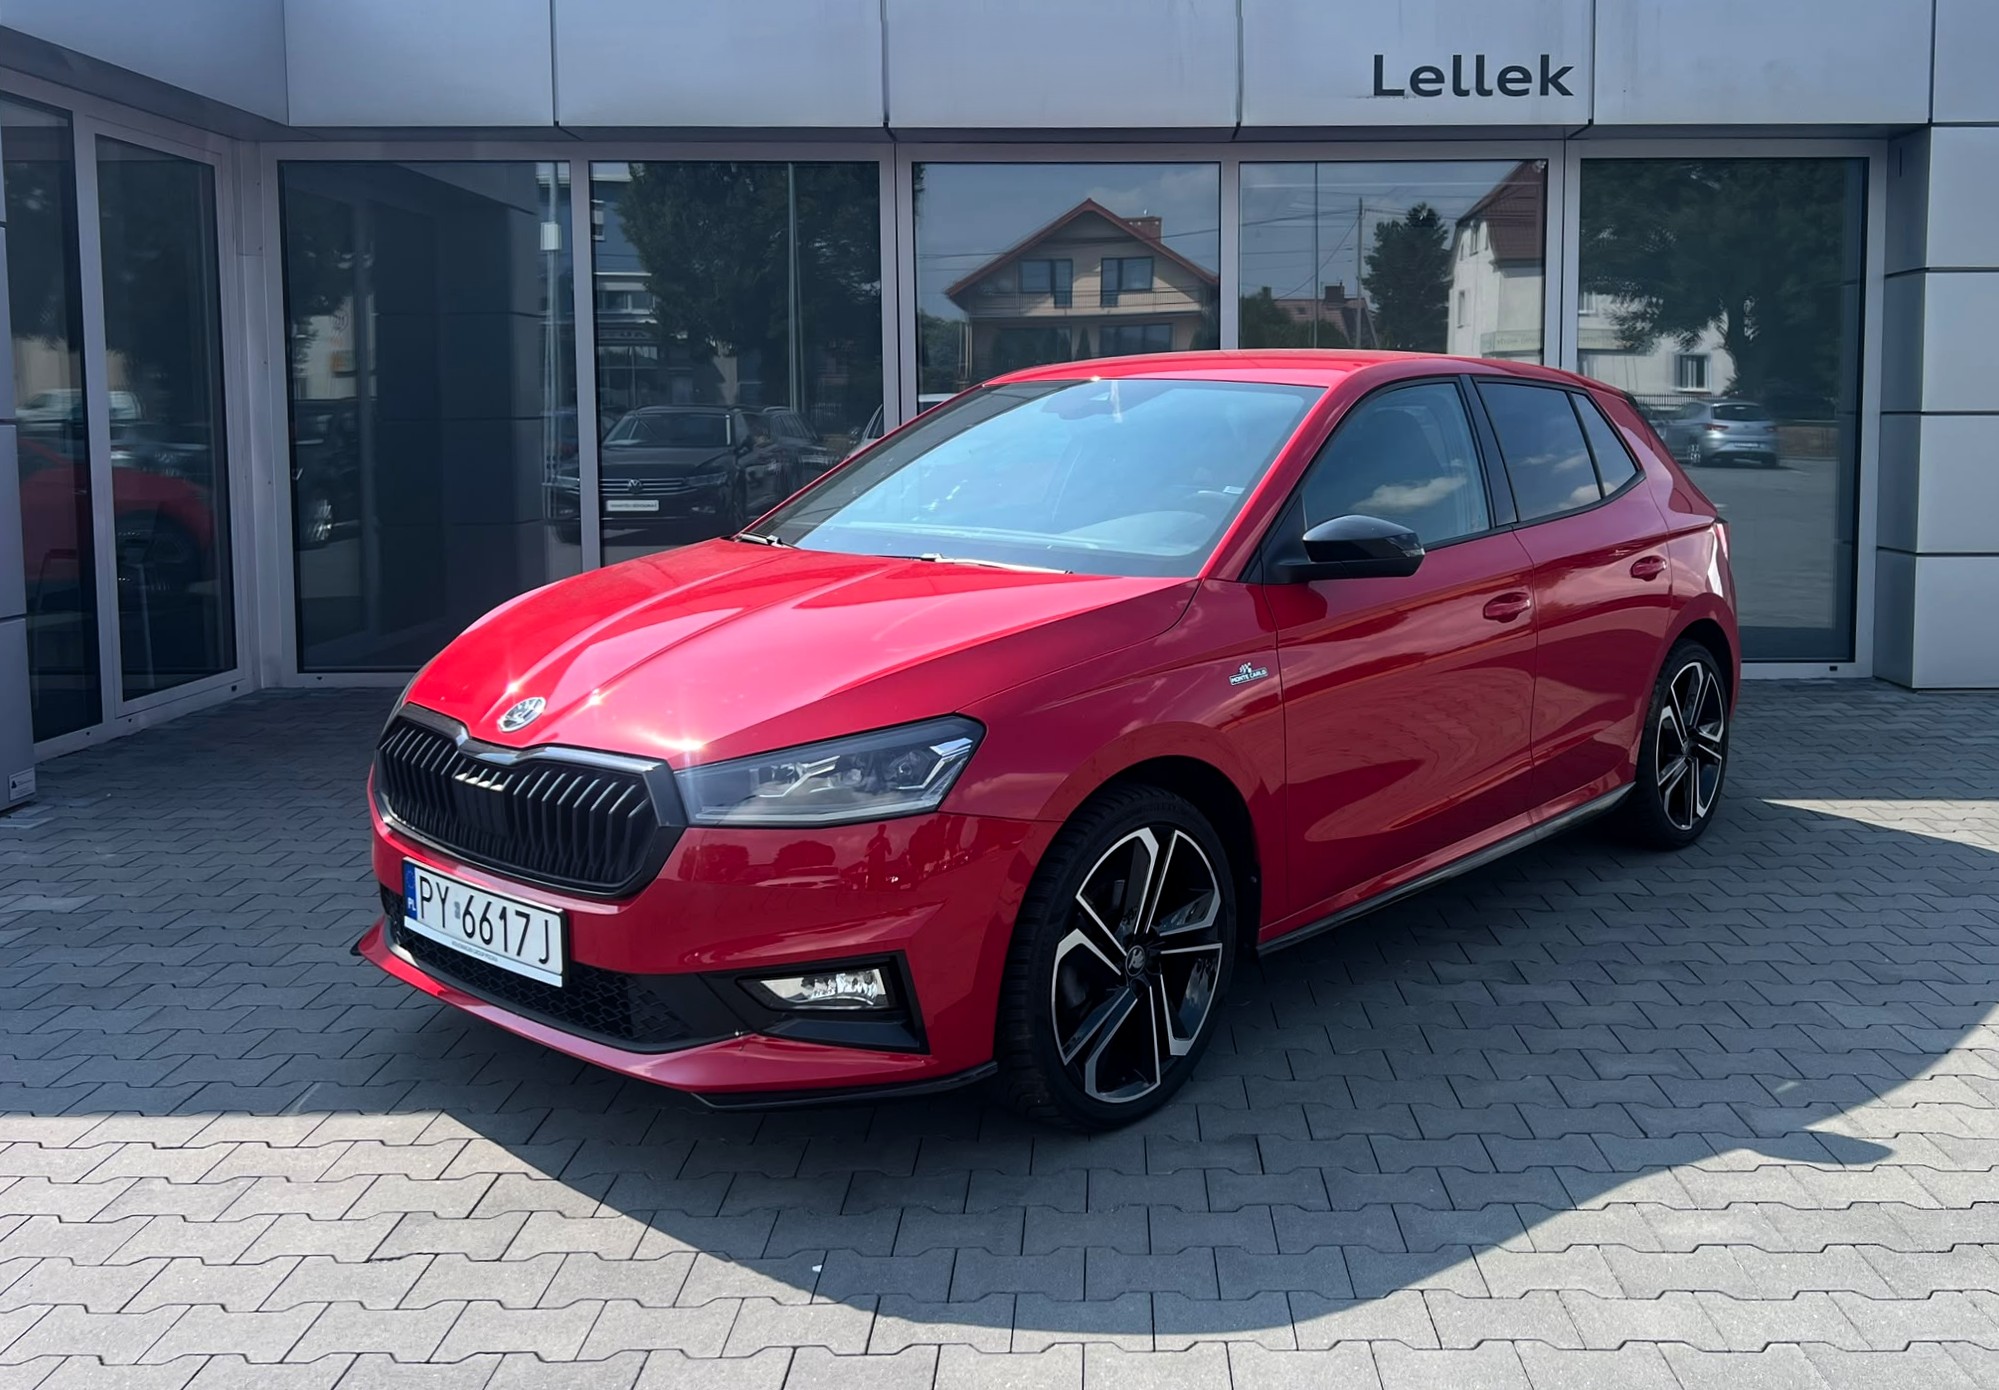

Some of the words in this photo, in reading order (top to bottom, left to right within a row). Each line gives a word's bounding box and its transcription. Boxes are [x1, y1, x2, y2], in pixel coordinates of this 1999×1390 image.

[1373, 54, 1575, 97] Lellek
[407, 897, 417, 912] PL
[420, 876, 449, 928] PY
[463, 894, 550, 965] 6617J
